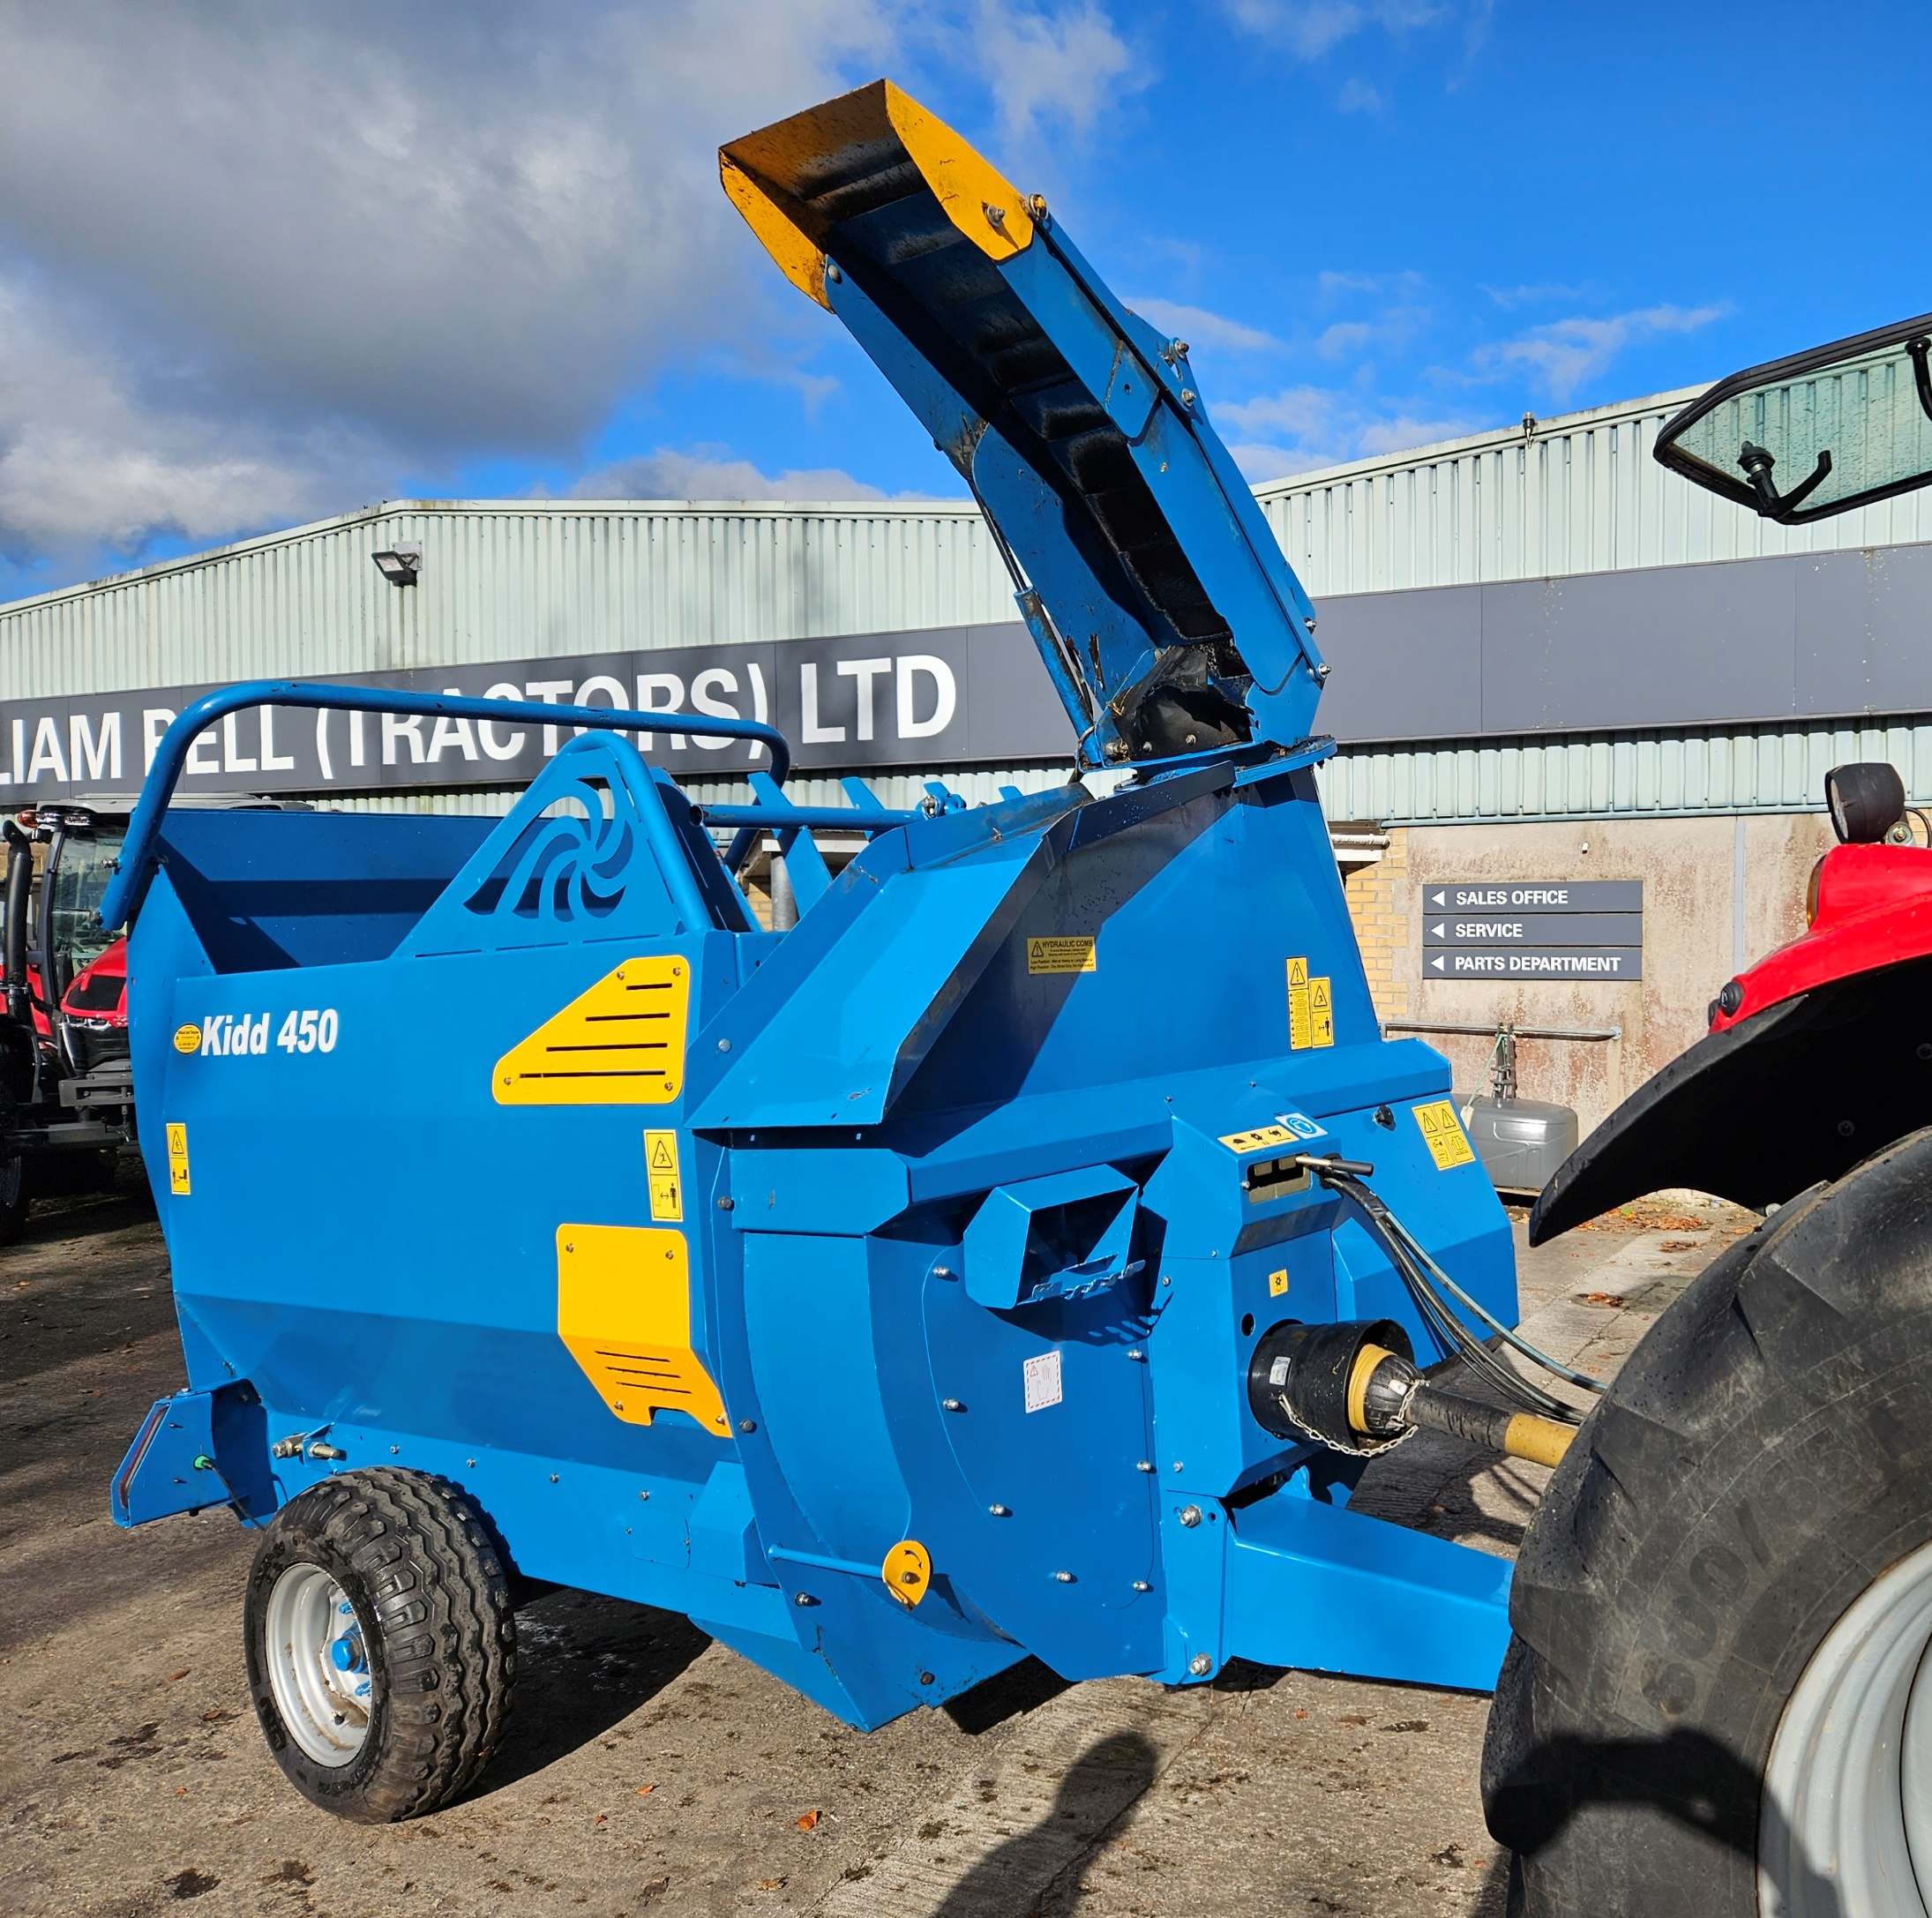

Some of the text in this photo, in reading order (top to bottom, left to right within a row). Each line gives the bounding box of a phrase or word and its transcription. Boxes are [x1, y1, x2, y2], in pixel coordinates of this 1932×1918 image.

[801, 655, 956, 744] LTD
[1456, 889, 1569, 905] SALES OFFICE
[1455, 923, 1523, 938] SERVICE
[1455, 956, 1621, 971] PARTS DEPARTMENT
[200, 1013, 270, 1056] Kidd
[277, 1008, 339, 1053] 450
